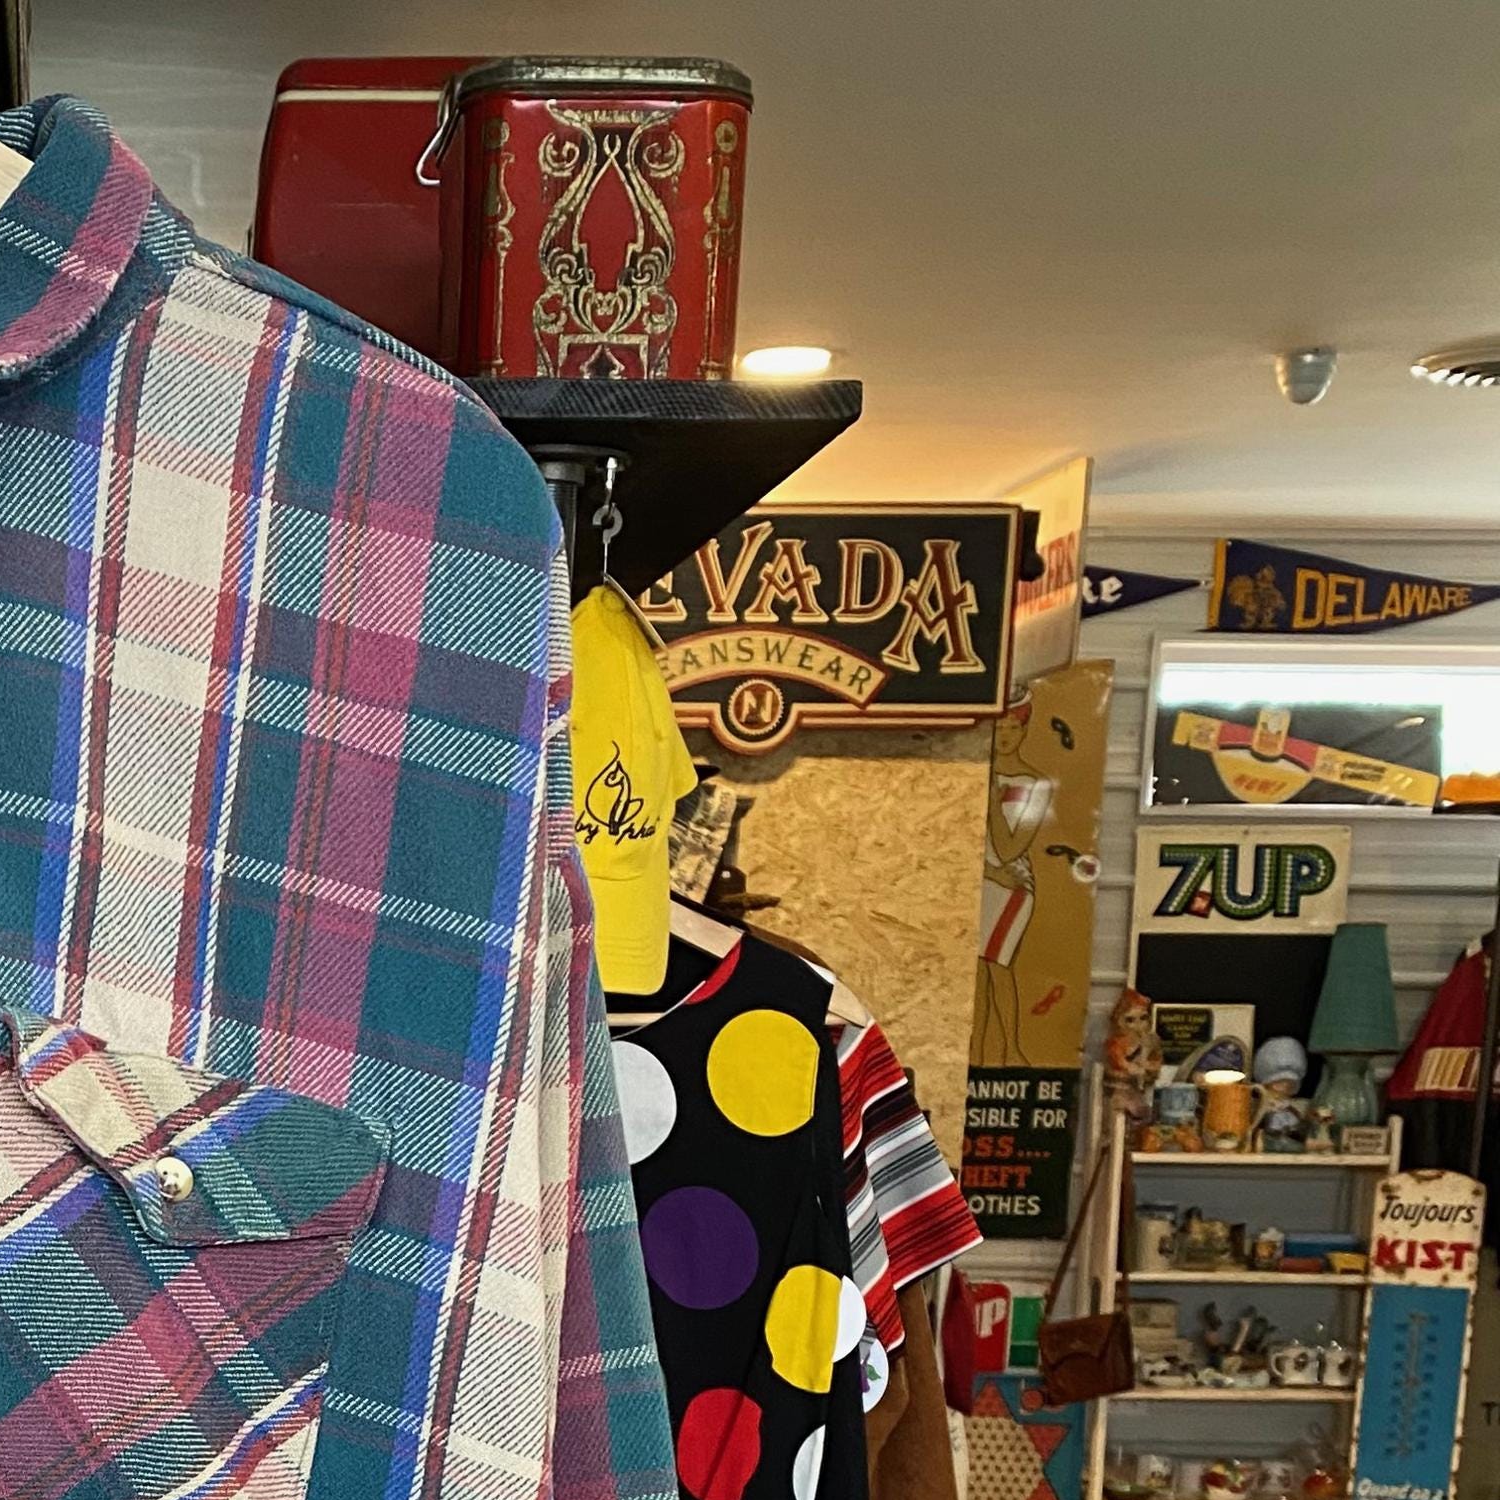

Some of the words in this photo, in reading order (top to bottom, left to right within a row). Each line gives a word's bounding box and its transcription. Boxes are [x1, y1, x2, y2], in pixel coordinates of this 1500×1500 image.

[1292, 567, 1472, 630] DELAWARE
[1153, 844, 1337, 920] 7UP
[1037, 1081, 1063, 1101] BE
[1032, 1109, 1068, 1129] FOR
[1380, 1195, 1477, 1228] Toujours
[1374, 1236, 1475, 1271] KIST
